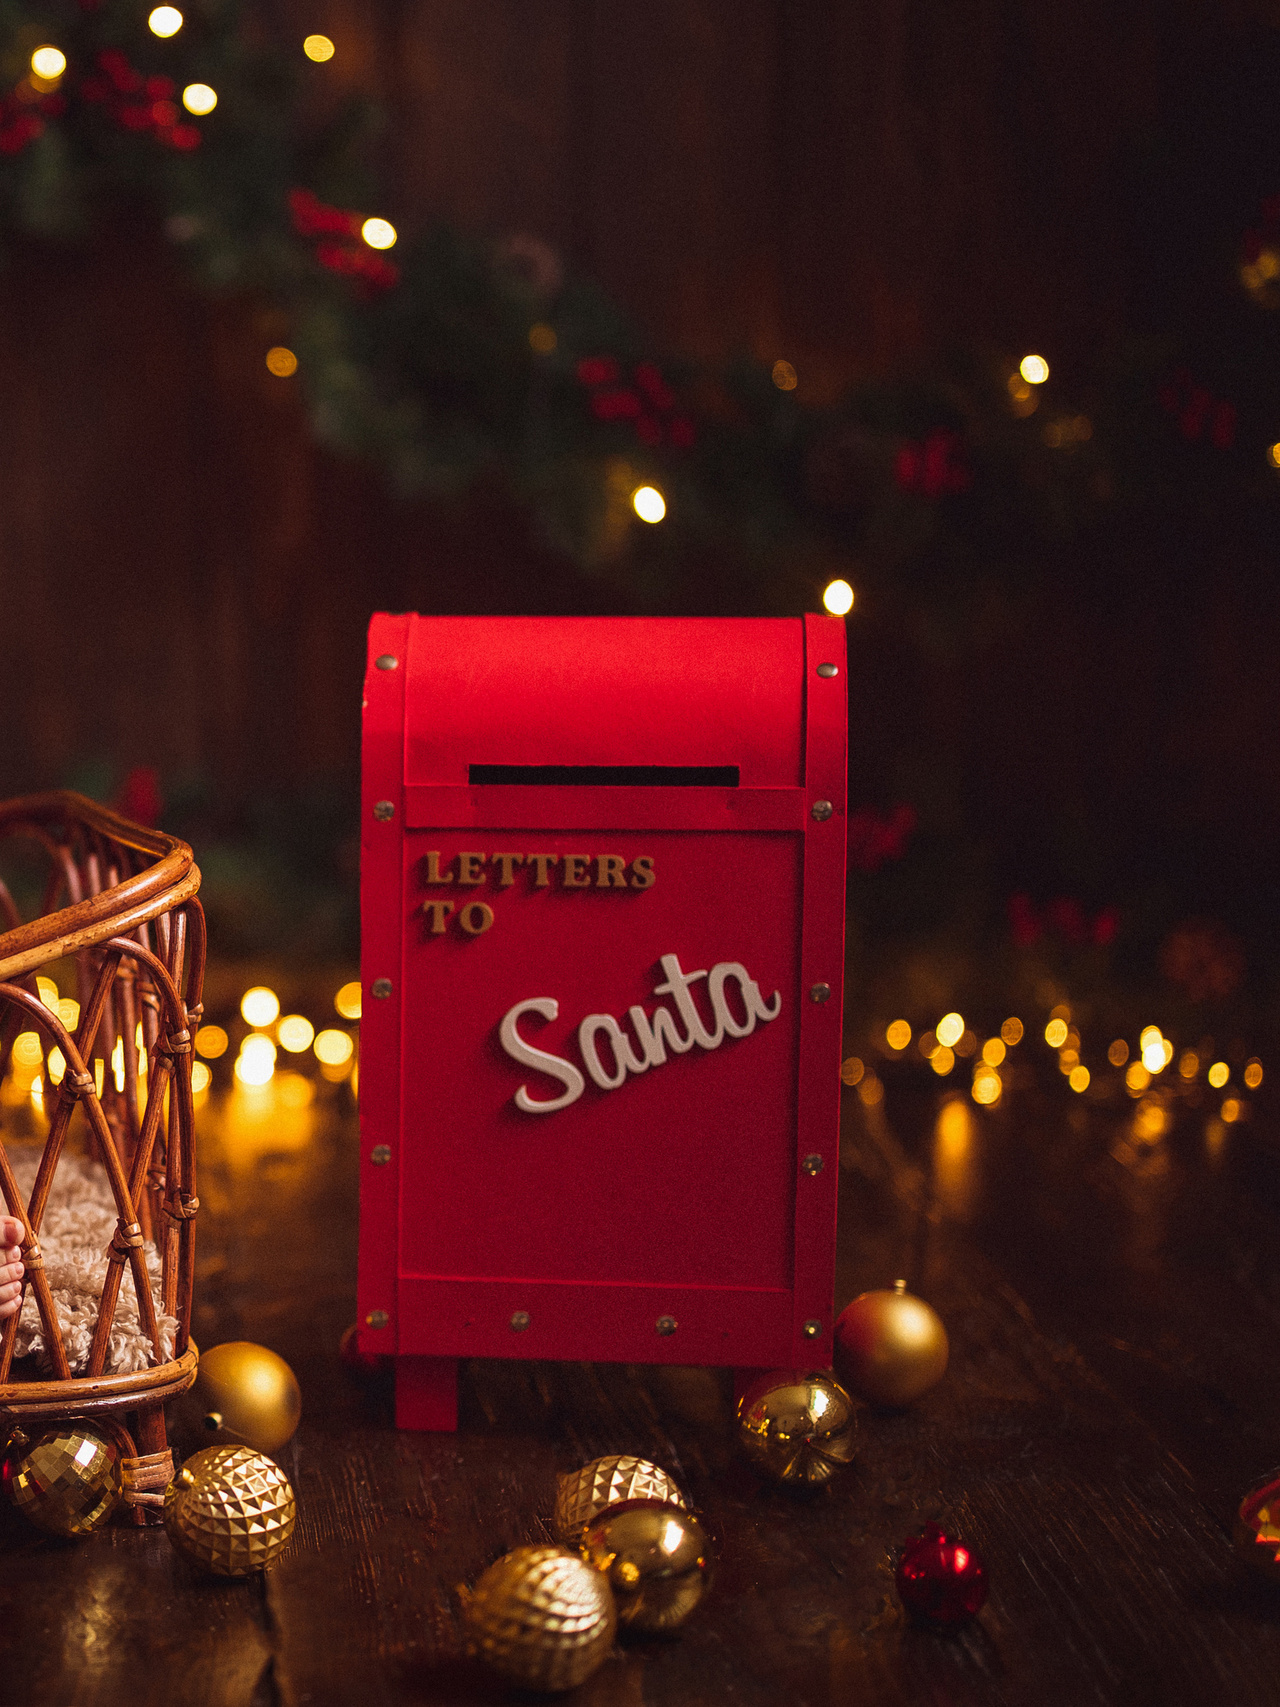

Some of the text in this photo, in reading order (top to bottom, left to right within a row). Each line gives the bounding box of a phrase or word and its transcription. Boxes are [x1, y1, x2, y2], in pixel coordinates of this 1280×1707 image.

[426, 851, 656, 888] LETTERS
[423, 900, 494, 934] TO
[499, 953, 782, 1113] Santa
